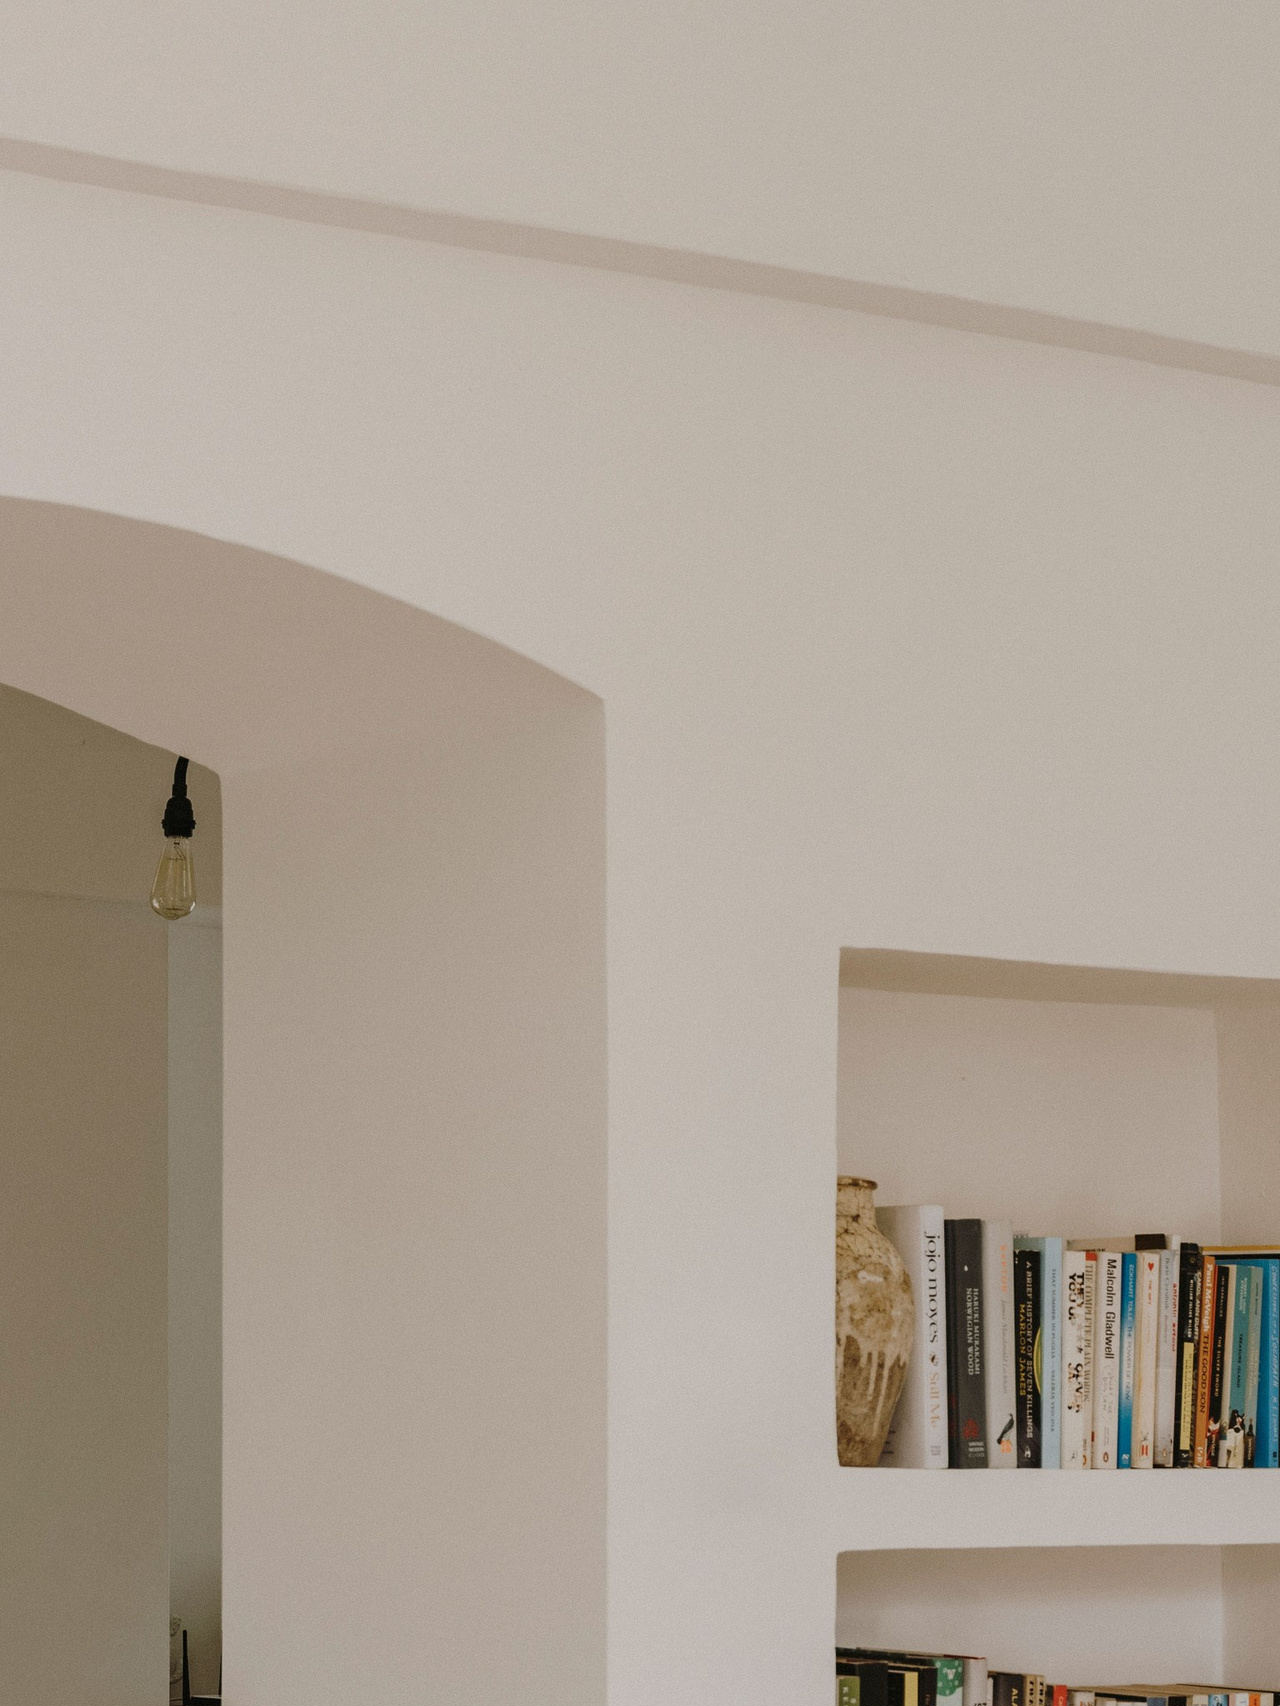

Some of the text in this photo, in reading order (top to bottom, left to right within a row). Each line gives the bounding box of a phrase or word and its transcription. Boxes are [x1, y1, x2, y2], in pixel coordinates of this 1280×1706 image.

[924, 1231, 941, 1343] jojo moyes
[1206, 1264, 1214, 1287] Paul
[966, 1287, 975, 1376] NORWEGIAN WOOD
[1104, 1259, 1117, 1359] Malcolm Gladwell
[1203, 1289, 1211, 1332] McVeigh
[973, 1325, 981, 1374] MURAKAMI
[1026, 1345, 1033, 1358] OF
[1199, 1392, 1207, 1413] SON
